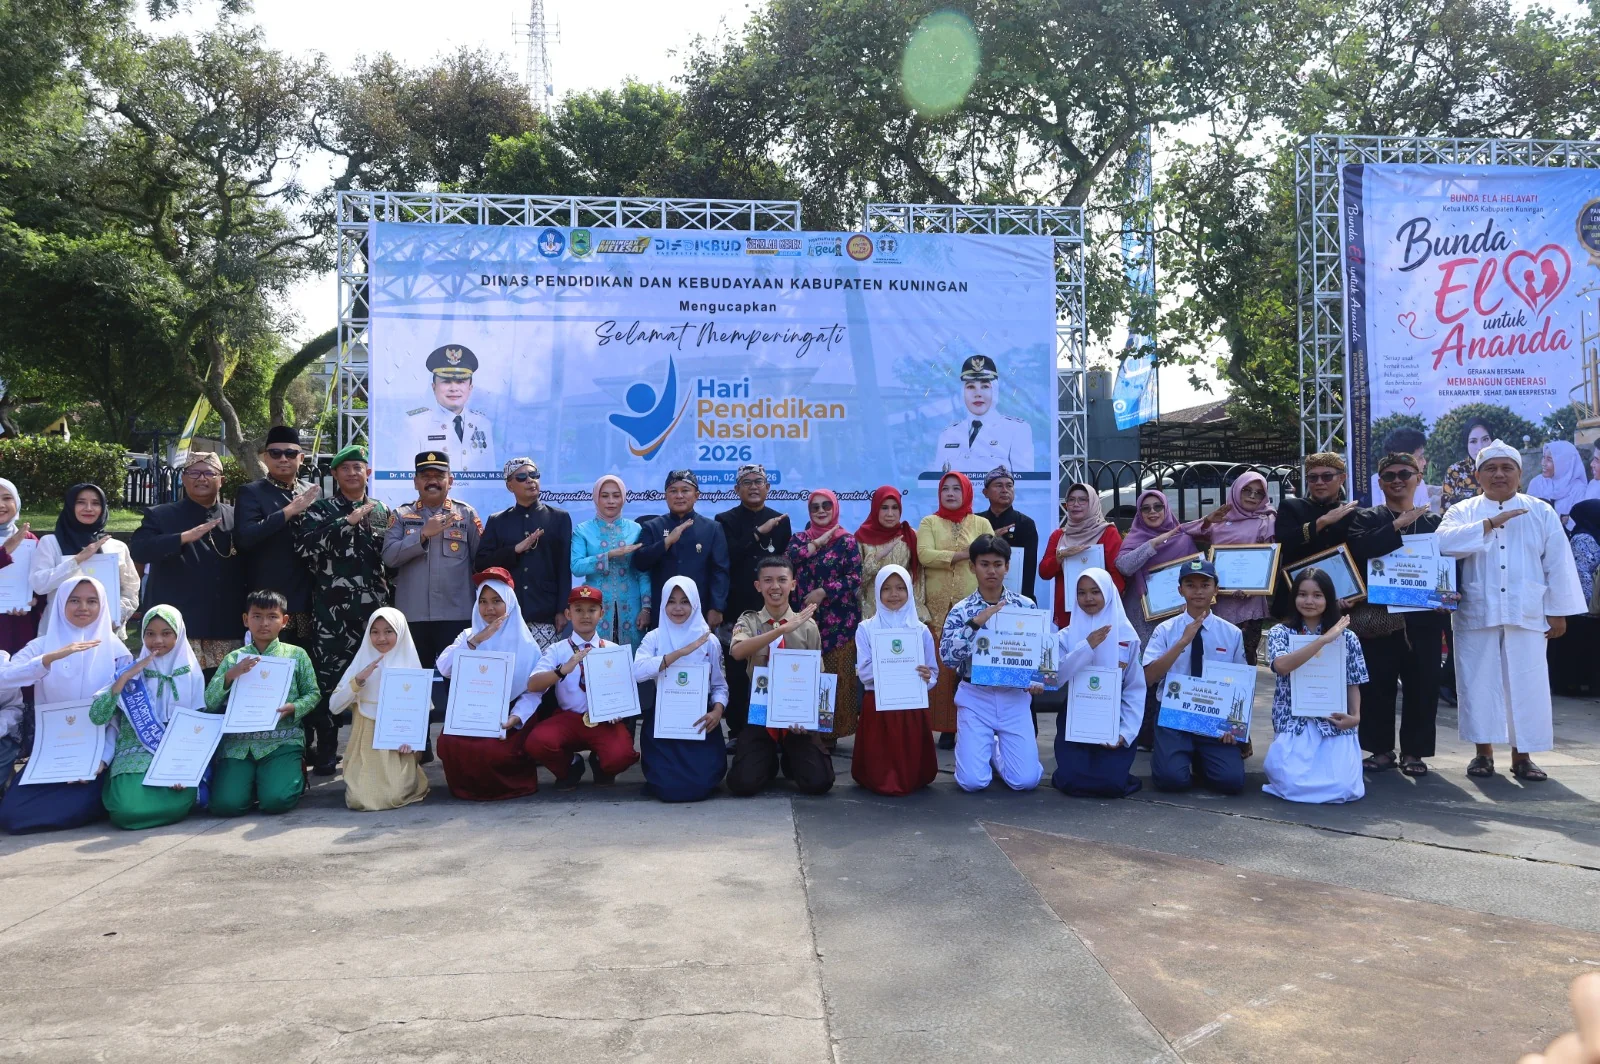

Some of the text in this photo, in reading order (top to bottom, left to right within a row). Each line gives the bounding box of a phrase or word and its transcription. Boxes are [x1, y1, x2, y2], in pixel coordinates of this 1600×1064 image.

[1450, 194, 1538, 203] BUNDA ELA HELAYATI
[1462, 205, 1479, 213] LKKS
[1480, 206, 1514, 214] Kabupaten
[1515, 206, 1544, 215] Kuningan
[596, 245, 646, 253] MELESAT
[1396, 216, 1511, 272] Bunda
[1347, 203, 1362, 344] Bunda El untuk Ananda
[480, 274, 969, 292] DINAS PENDIDIKAN DAN KEBUDAYAAN KABUPATEN KUNINGAN
[1434, 257, 1504, 325] El
[679, 300, 777, 314] Mengucapkan
[1482, 309, 1527, 329] untuk
[595, 320, 847, 358] Selamat Memperingati
[1431, 315, 1573, 371] Ananda
[697, 377, 749, 398] Hari
[1446, 377, 1547, 386] MEMBANGUN GENERASI
[697, 398, 845, 419] Pendidikan
[697, 419, 809, 439] Nasional
[698, 445, 752, 462] 2026
[459, 472, 488, 480] YANUAR,
[723, 473, 735, 481] 02
[766, 473, 777, 481] 26
[840, 490, 869, 500] untuk
[1400, 578, 1427, 587] 500.000
[991, 656, 1033, 667] RP. 1.000.000
[1191, 686, 1212, 695] JUARA
[125, 695, 135, 710] DUTA
[131, 708, 146, 732] PUSTAKA
[133, 690, 154, 725] FAVORITE
[1182, 701, 1220, 715] RP. 750.000
